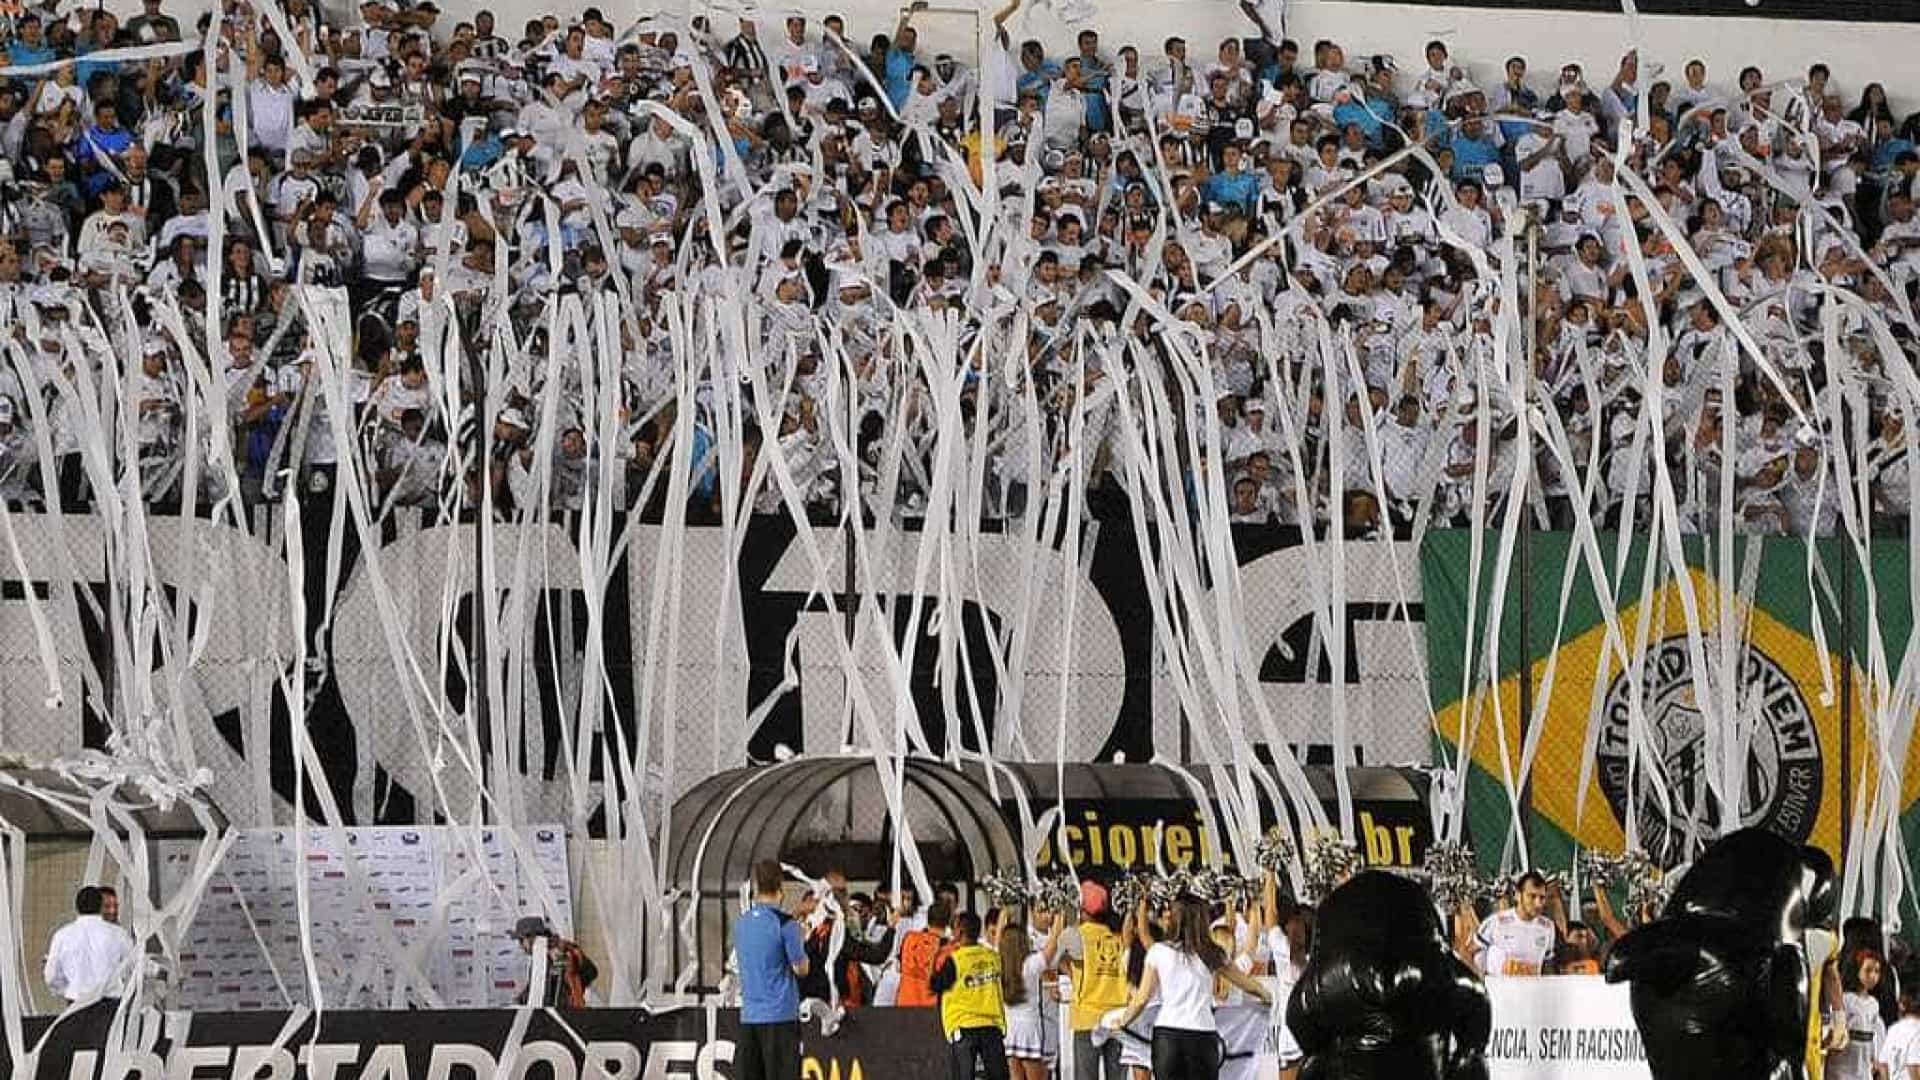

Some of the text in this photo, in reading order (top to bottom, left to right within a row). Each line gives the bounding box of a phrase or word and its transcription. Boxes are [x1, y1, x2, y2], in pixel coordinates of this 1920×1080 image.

[1605, 645, 1811, 753] TOID OVEM
[1484, 1027, 1533, 1066] NCIA,
[1538, 1027, 1572, 1060] SEM
